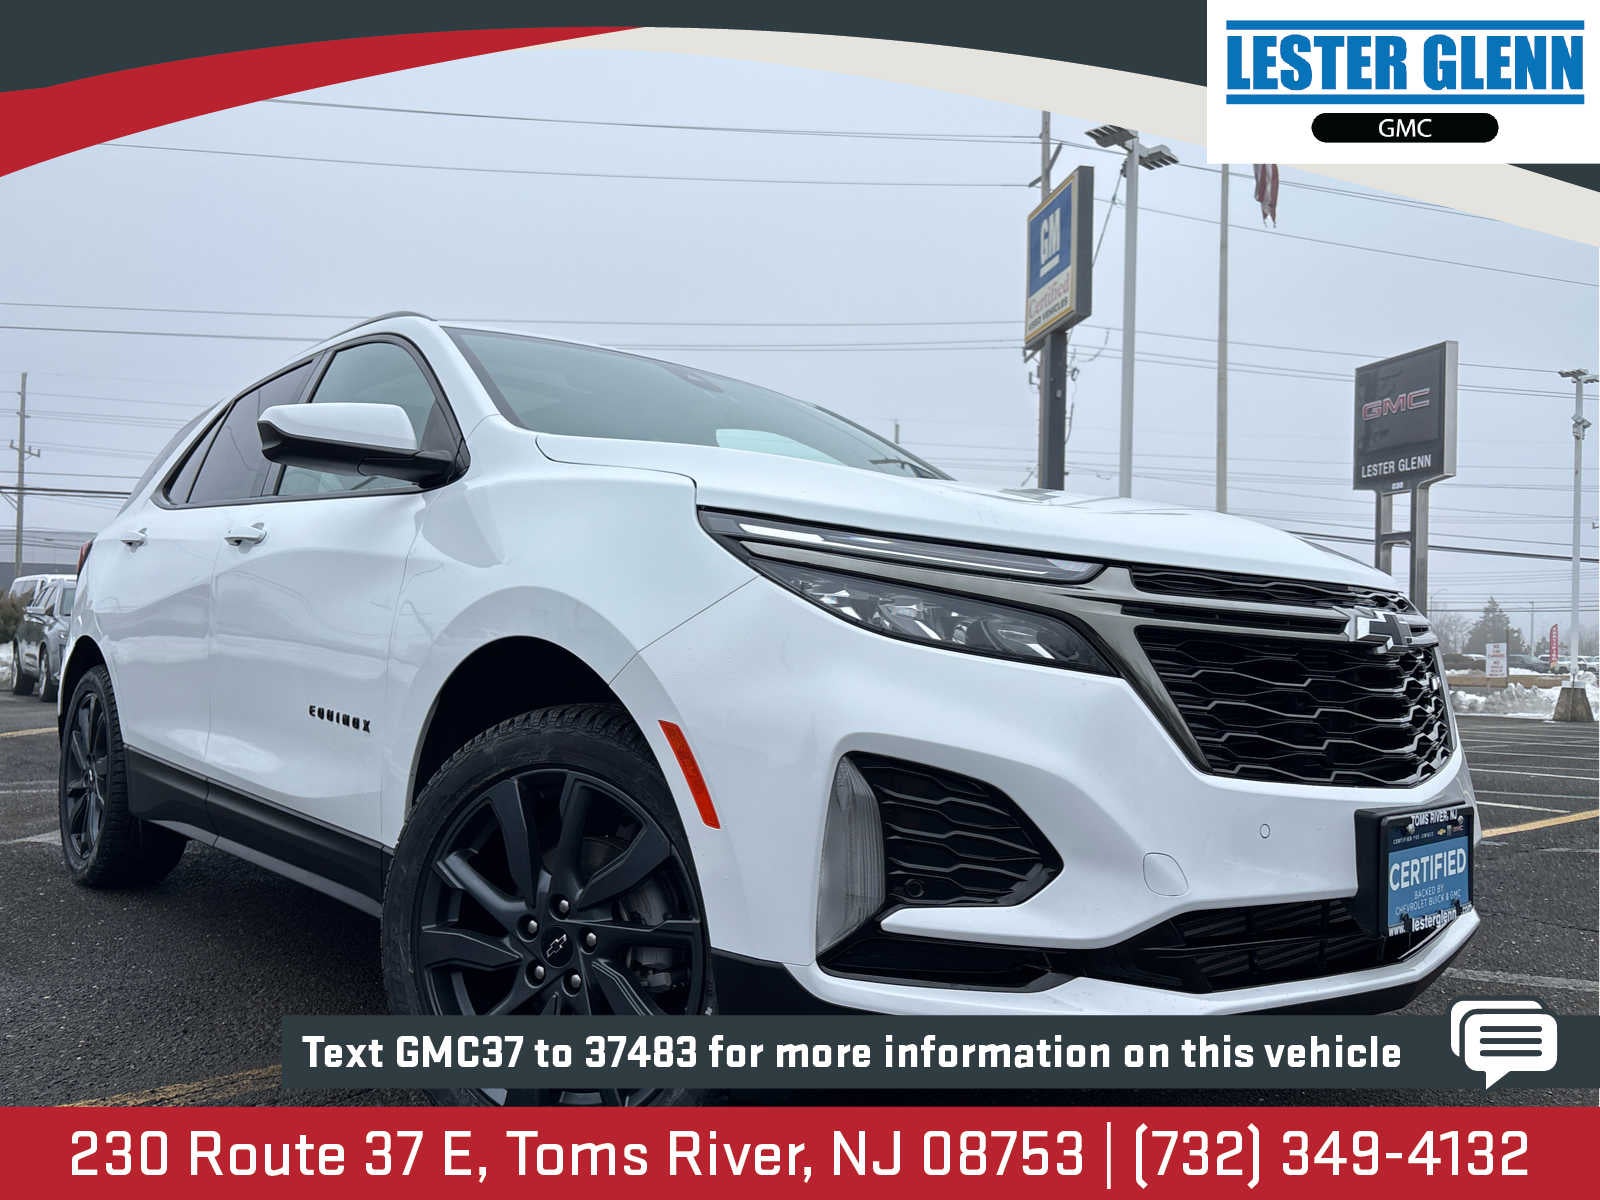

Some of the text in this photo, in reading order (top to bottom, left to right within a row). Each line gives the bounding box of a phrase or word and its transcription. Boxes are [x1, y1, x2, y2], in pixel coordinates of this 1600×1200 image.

[1040, 208, 1061, 264] GM
[1362, 388, 1430, 421] GMC
[1361, 454, 1432, 478] LESTER GLENN
[309, 705, 371, 733] EQUINOX
[1411, 813, 1430, 827] TOMS
[1389, 848, 1467, 891] CERTIFIED
[1414, 886, 1436, 900] BACKED
[1395, 899, 1427, 916] CHEVROLET
